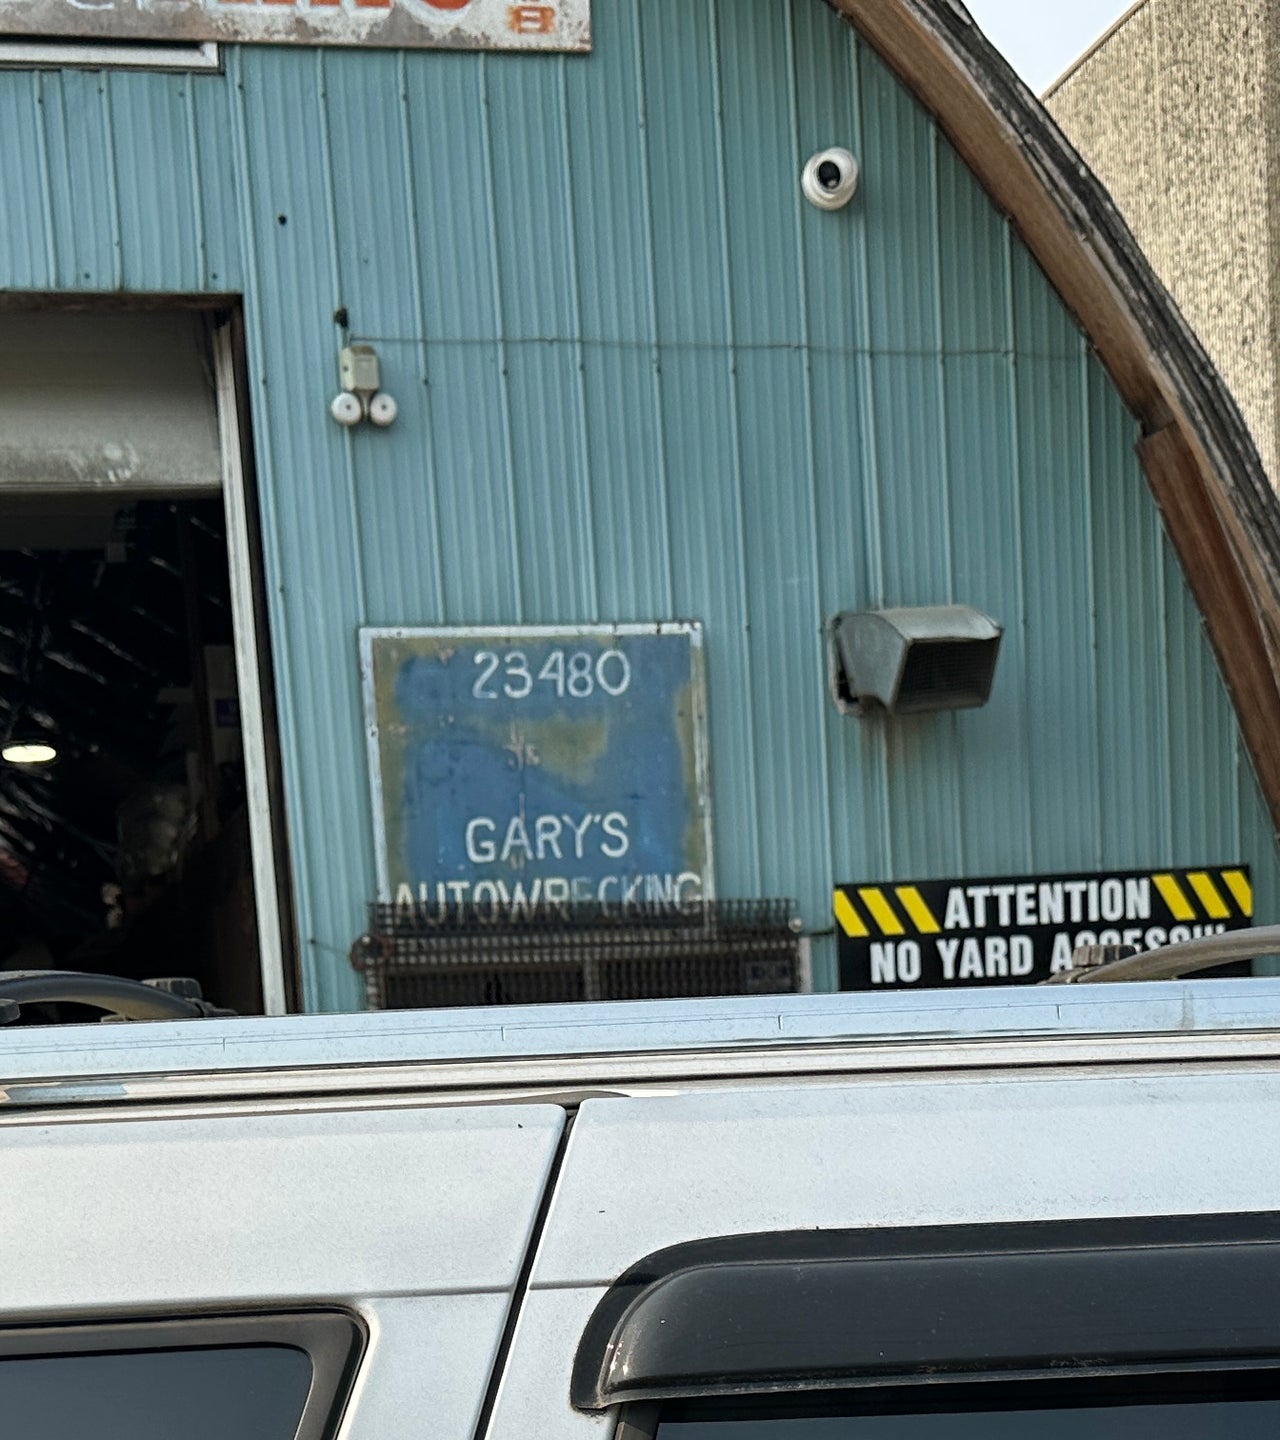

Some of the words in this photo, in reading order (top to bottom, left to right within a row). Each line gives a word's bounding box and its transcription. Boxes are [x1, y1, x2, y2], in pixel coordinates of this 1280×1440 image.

[472, 649, 632, 699] 23480
[465, 811, 630, 863] GARY'S
[944, 877, 1151, 930] ATTENTION
[870, 940, 921, 984] NO
[937, 934, 1034, 980] YARD
